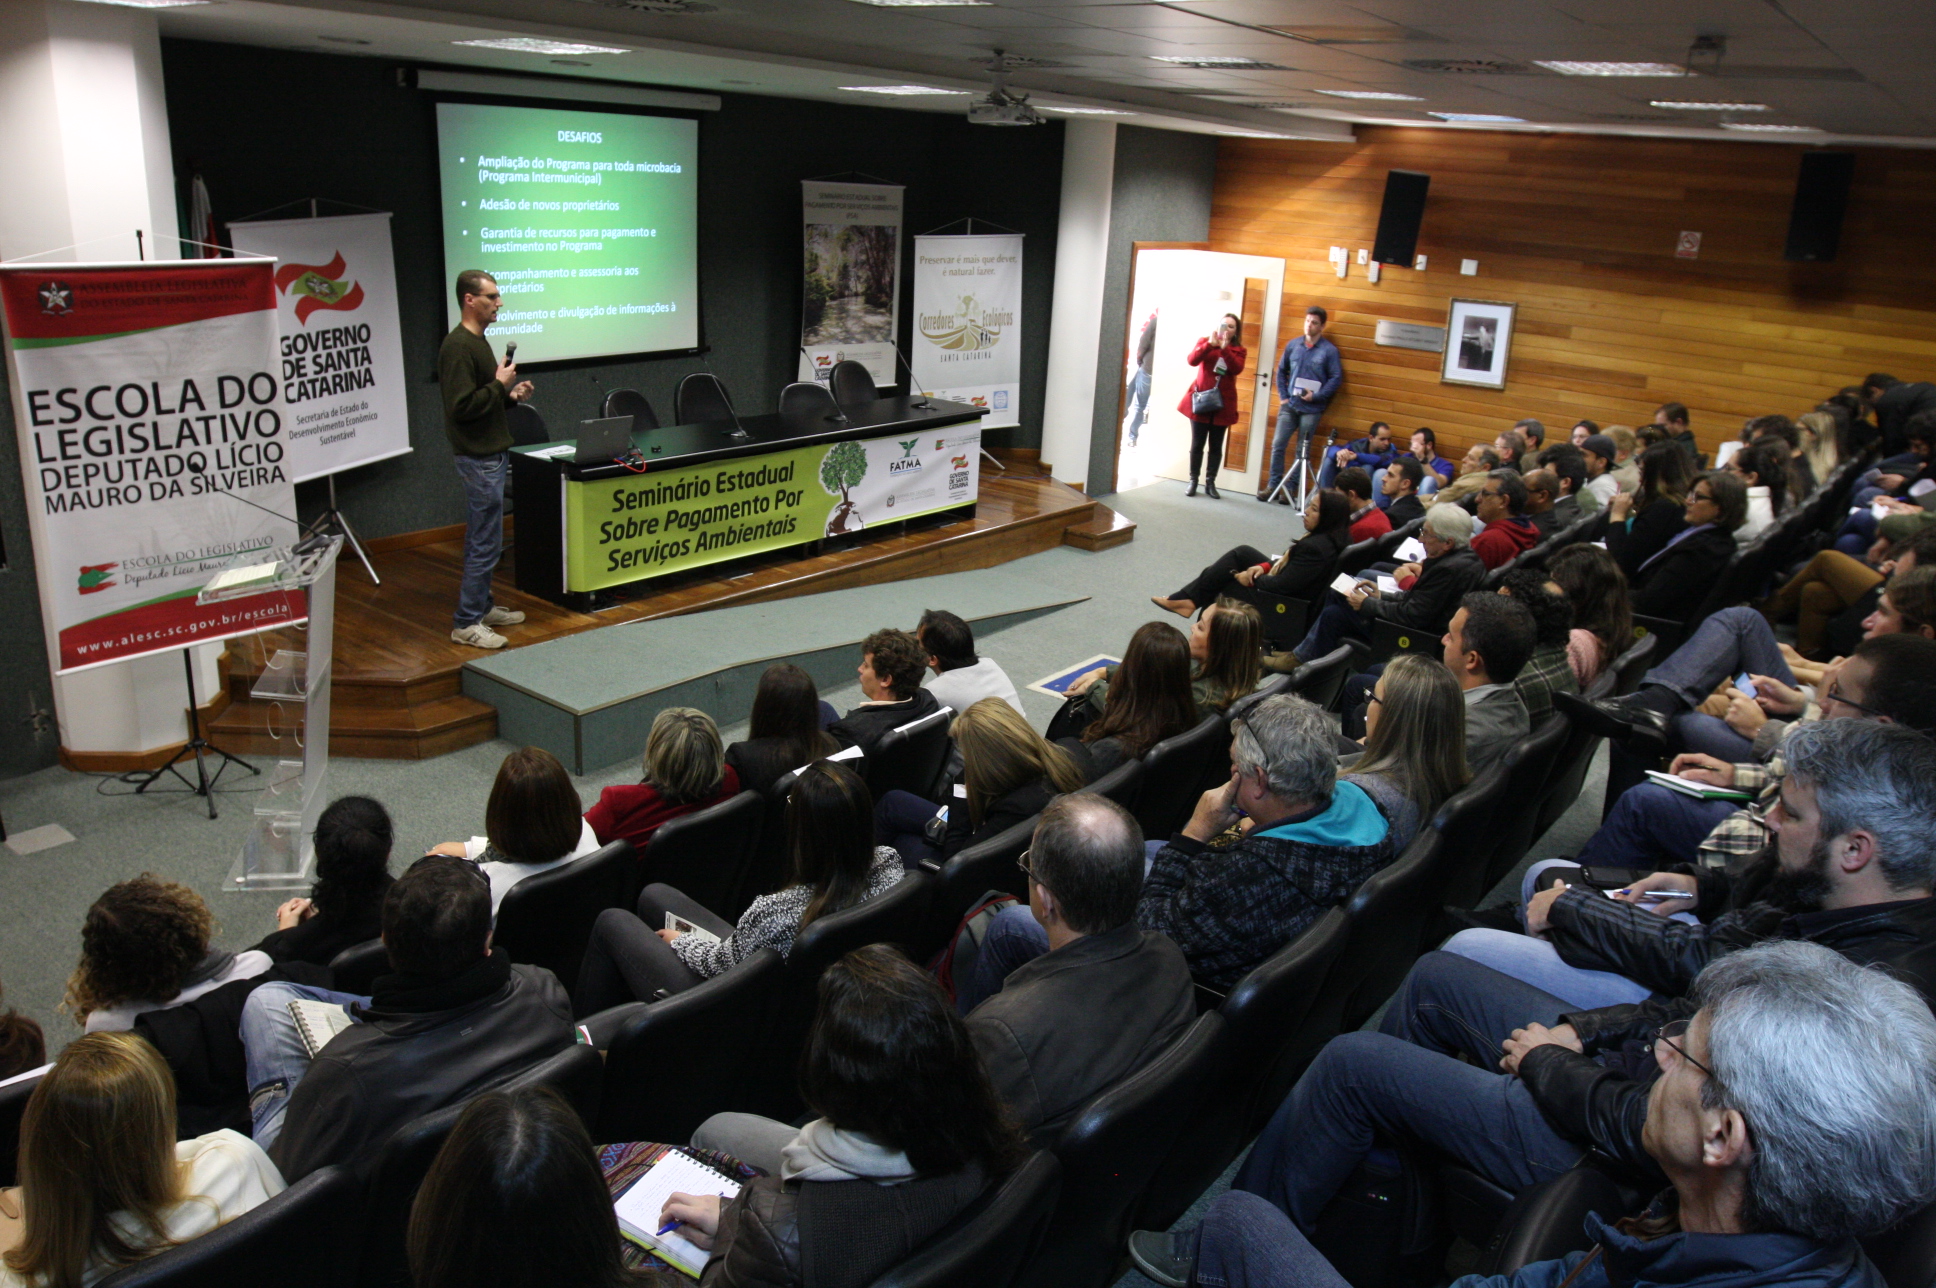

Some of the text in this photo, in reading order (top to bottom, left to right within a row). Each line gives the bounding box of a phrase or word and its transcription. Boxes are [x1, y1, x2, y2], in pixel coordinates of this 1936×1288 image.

[558, 130, 602, 144] DESAFIOS
[478, 156, 682, 173] Ampliação do Programa para toda microbacia
[479, 170, 602, 186] (Programa Intermunicipal)
[480, 198, 620, 212] Adesão de novos proprietários
[480, 227, 656, 240] Garantia de recursos para pagamento e
[482, 240, 602, 253] investimento no Programa
[919, 254, 1018, 265] Preservar é mais que dever,
[942, 266, 996, 276] é natural fazer.
[484, 266, 639, 281] companhamento e assessoria aos
[496, 282, 544, 295] prietários
[550, 310, 556, 319] e
[558, 305, 604, 319] divulgação
[606, 304, 617, 315] de
[619, 302, 669, 315] informações
[671, 302, 676, 311] à
[919, 307, 1013, 330] Corredores Ecológicos
[280, 323, 371, 357] GOVERNO
[484, 322, 543, 337] comunidade
[282, 345, 372, 381] DE SANTA
[941, 352, 991, 362] SANTA CATARINA
[284, 367, 375, 404] CATARINA
[28, 372, 277, 426] ESCOLA DO
[296, 401, 368, 425] Secretaria de Estado do
[34, 408, 281, 464] LEGISLATIVO
[289, 412, 378, 440] Desenvolvimento Econômico
[320, 428, 356, 446] Sustentável
[40, 441, 284, 492] DEPUTADO LÍCIO
[890, 458, 921, 472] FATMA
[45, 465, 286, 515] MAURO DA SILVEIRA
[612, 460, 794, 512] Seminário Estadual
[599, 489, 804, 544] Sobre Pagamento Por
[122, 536, 274, 570] ESCOLA DO LEGISLATIVO
[607, 514, 797, 572] Serviços Ambientais
[124, 571, 169, 587] Deputado
[172, 564, 194, 576] Lício
[77, 604, 288, 655] www.alesc.sc.gov.br/escola
